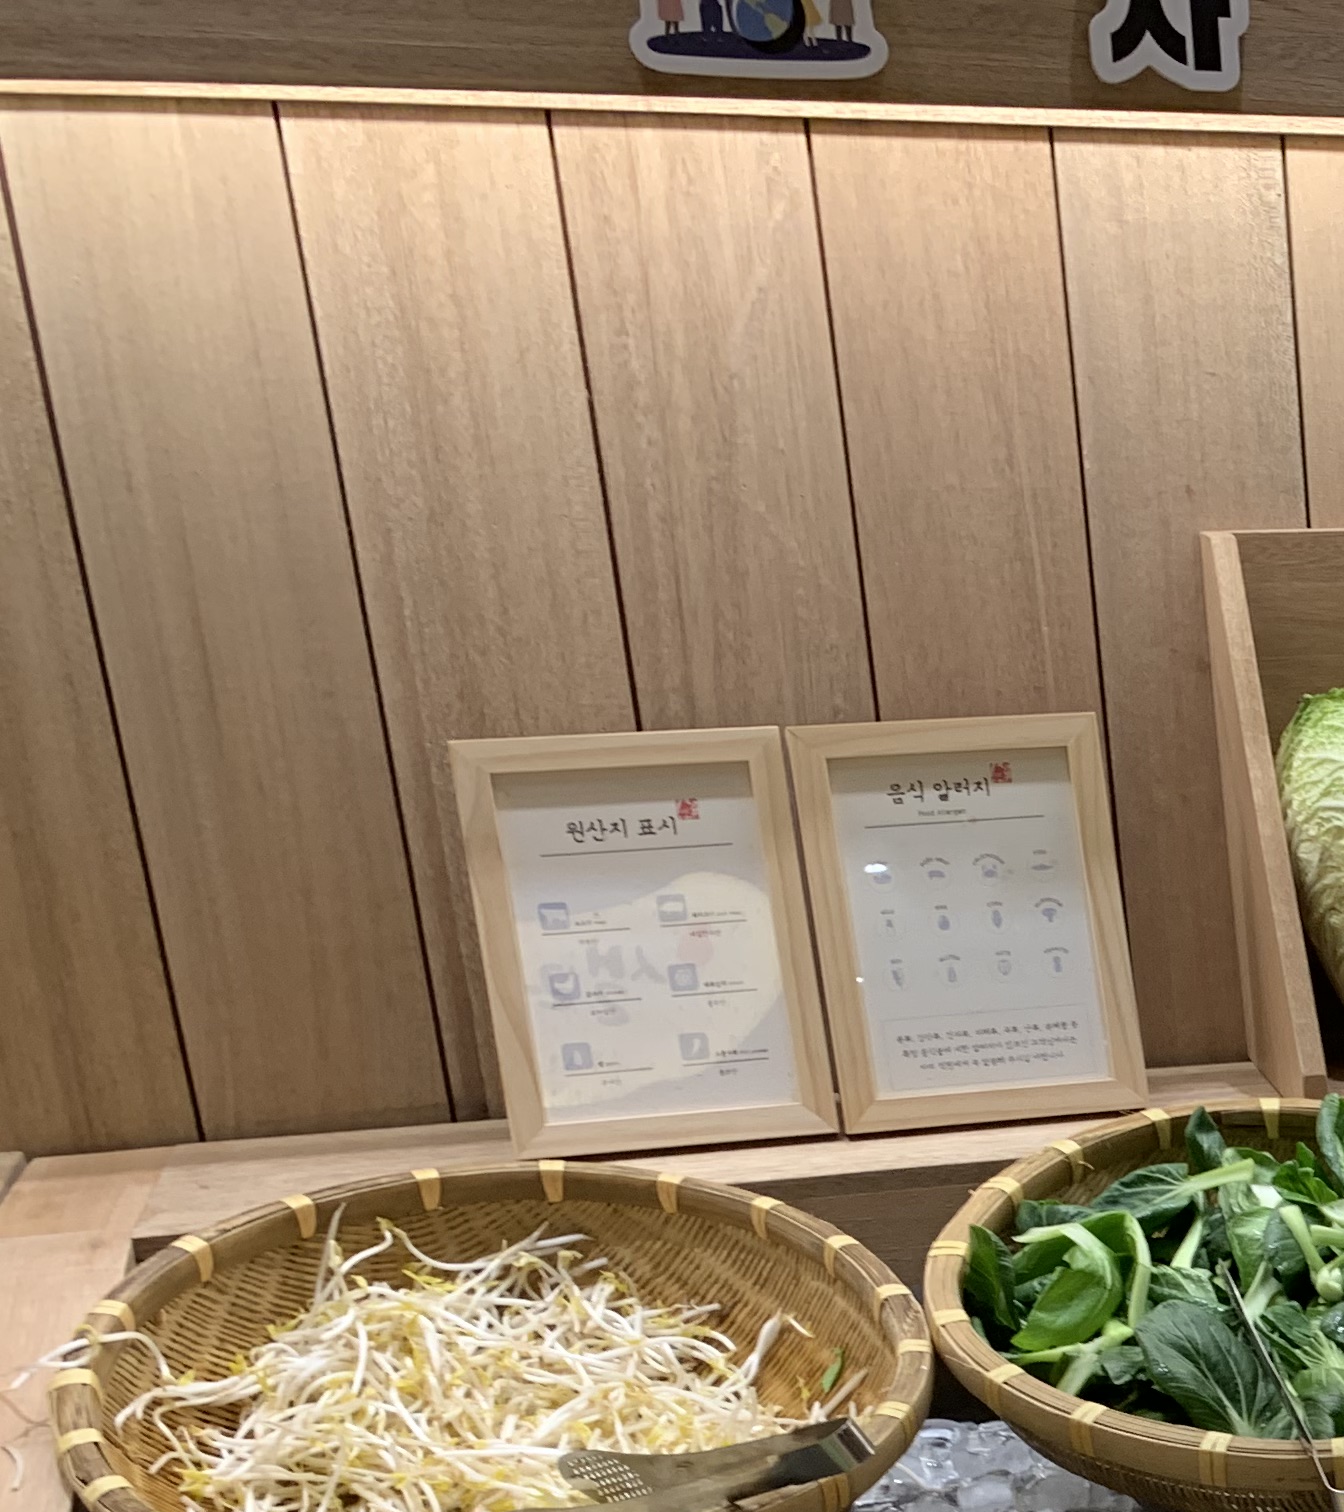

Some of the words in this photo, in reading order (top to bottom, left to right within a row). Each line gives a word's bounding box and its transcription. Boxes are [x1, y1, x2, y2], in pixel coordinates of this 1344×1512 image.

[887, 779, 925, 805] 음식
[932, 776, 991, 802] 알러지
[565, 817, 629, 843] 원산지
[637, 815, 678, 836] 표시
